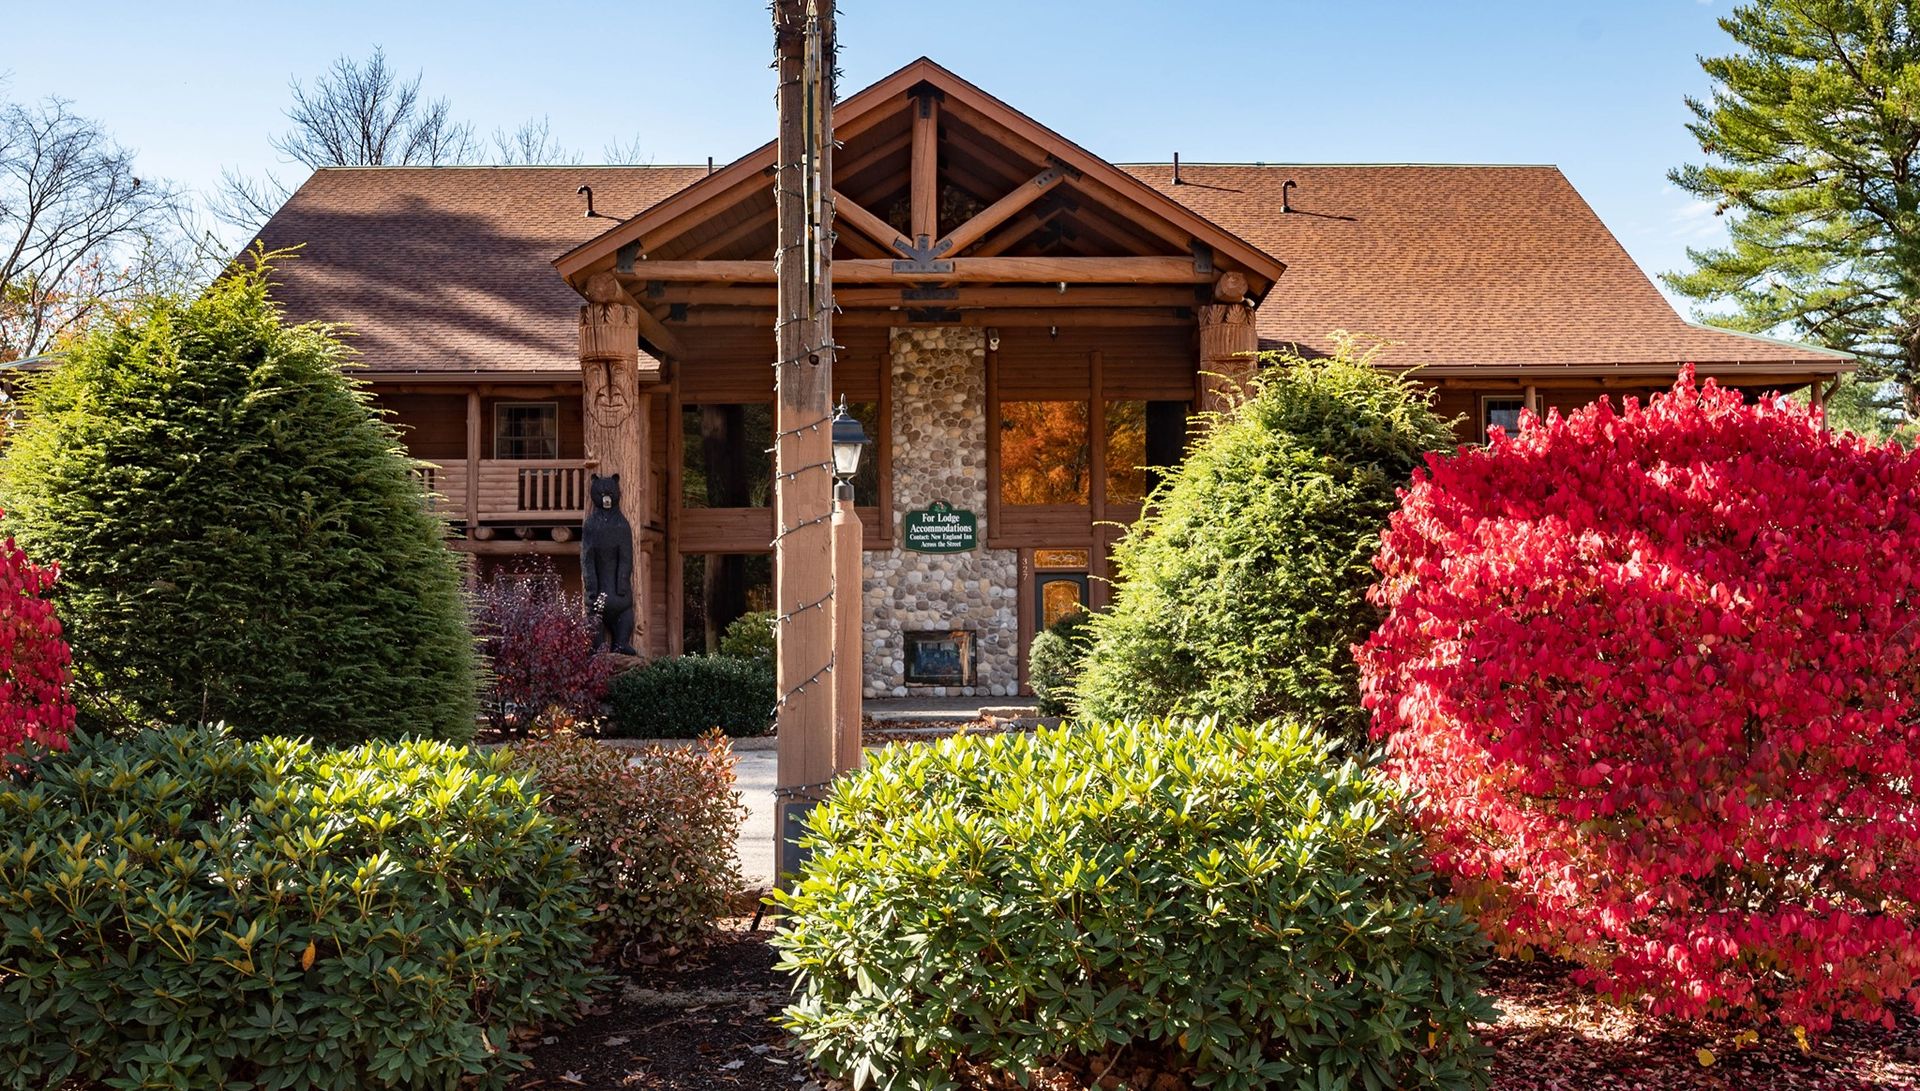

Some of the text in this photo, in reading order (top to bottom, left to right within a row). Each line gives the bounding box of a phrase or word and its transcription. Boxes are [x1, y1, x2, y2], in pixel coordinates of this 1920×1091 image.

[922, 513, 960, 524] For Lodge
[910, 523, 972, 533] Accommodations
